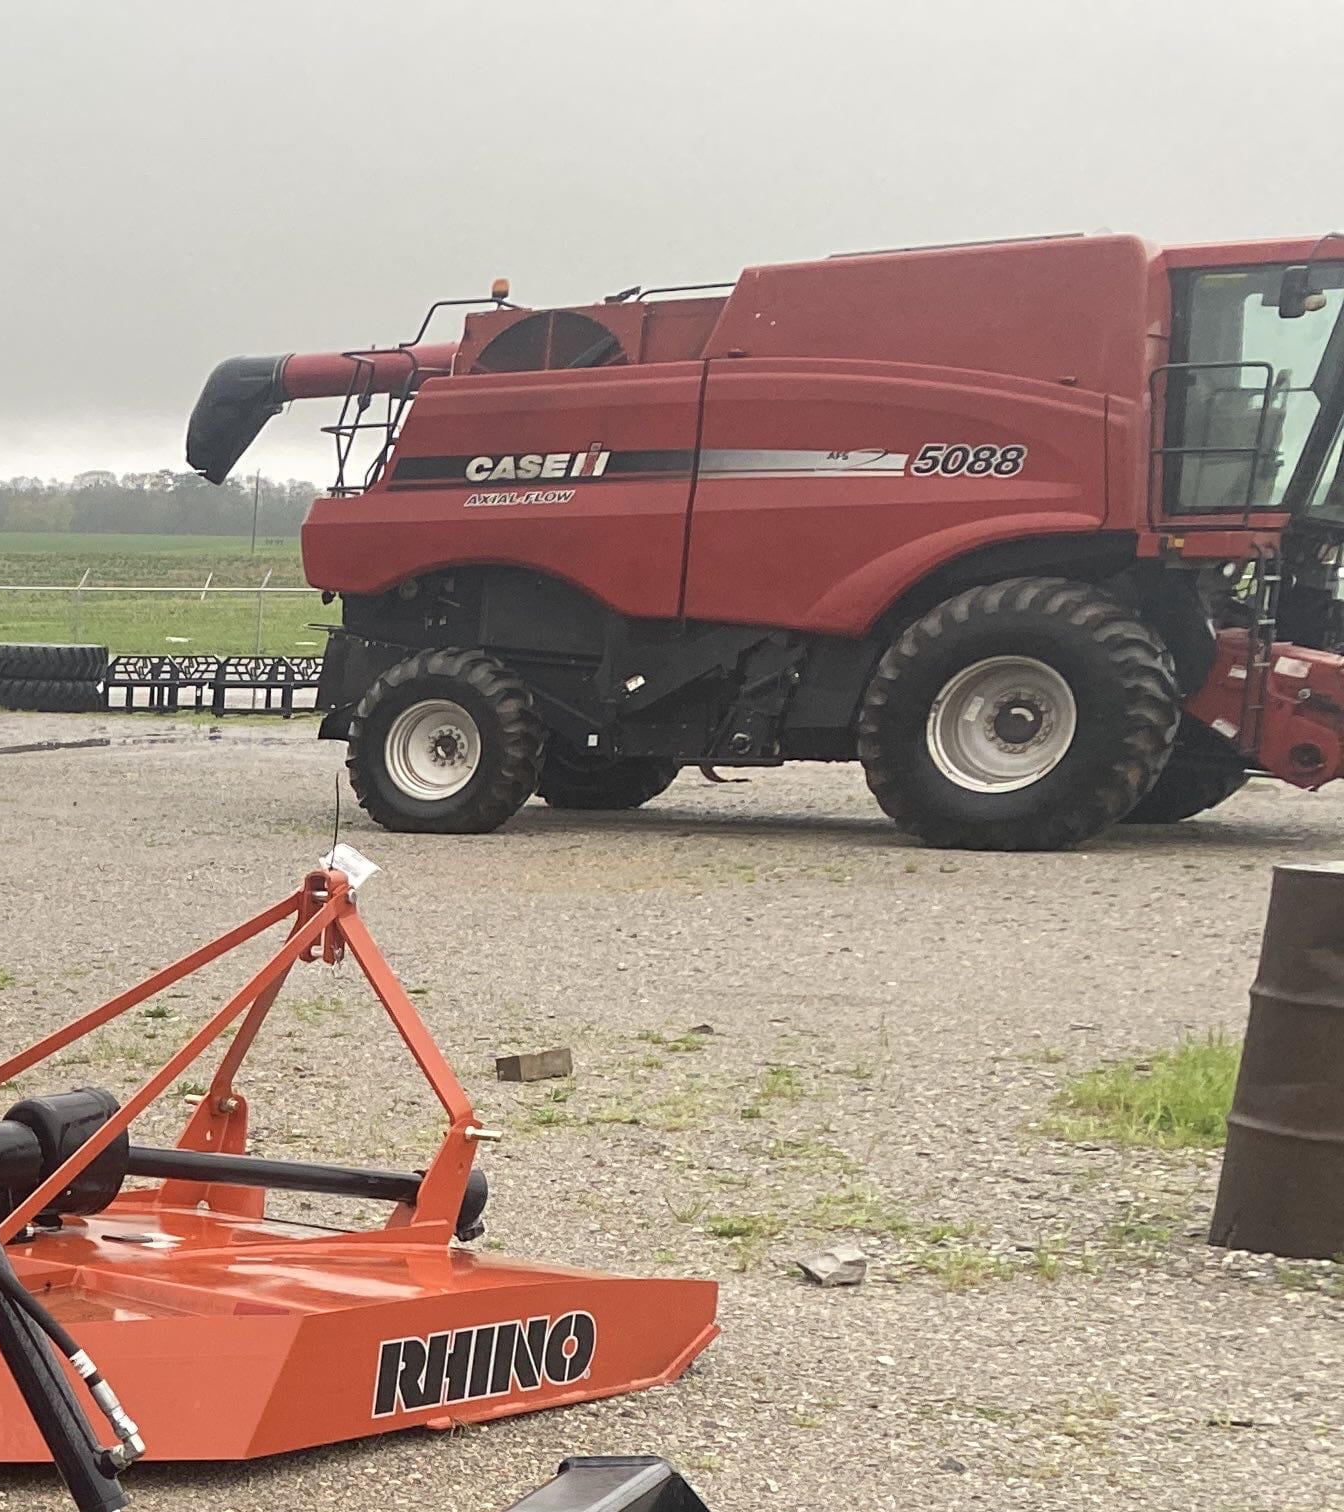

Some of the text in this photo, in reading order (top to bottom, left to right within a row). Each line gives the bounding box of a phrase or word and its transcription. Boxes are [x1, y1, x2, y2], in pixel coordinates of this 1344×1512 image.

[465, 453, 571, 482] CASE
[911, 443, 1028, 477] 5088
[464, 490, 575, 507] AXIAL-FLOW
[371, 1310, 597, 1419] RHINO
